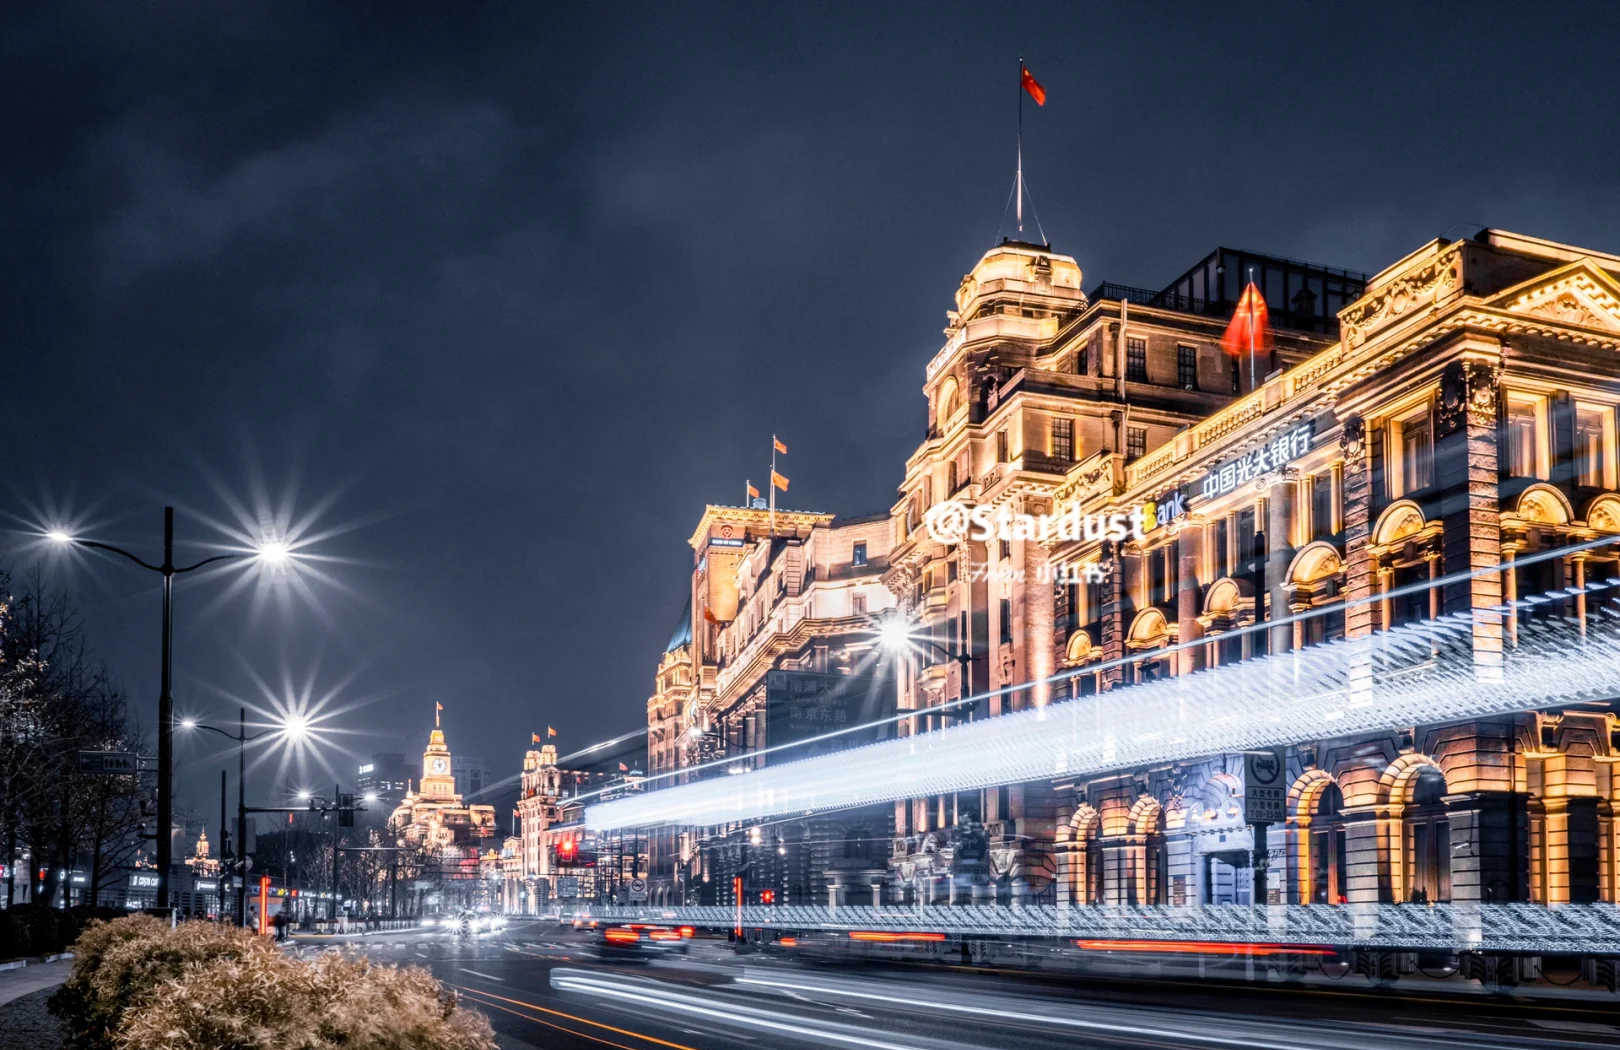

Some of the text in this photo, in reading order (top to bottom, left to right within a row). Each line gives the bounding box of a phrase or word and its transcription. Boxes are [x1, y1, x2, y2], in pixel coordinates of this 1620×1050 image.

[1203, 424, 1311, 499] 中国光大银行
[1143, 491, 1187, 534] Bank
[789, 706, 848, 723] 南京东路
